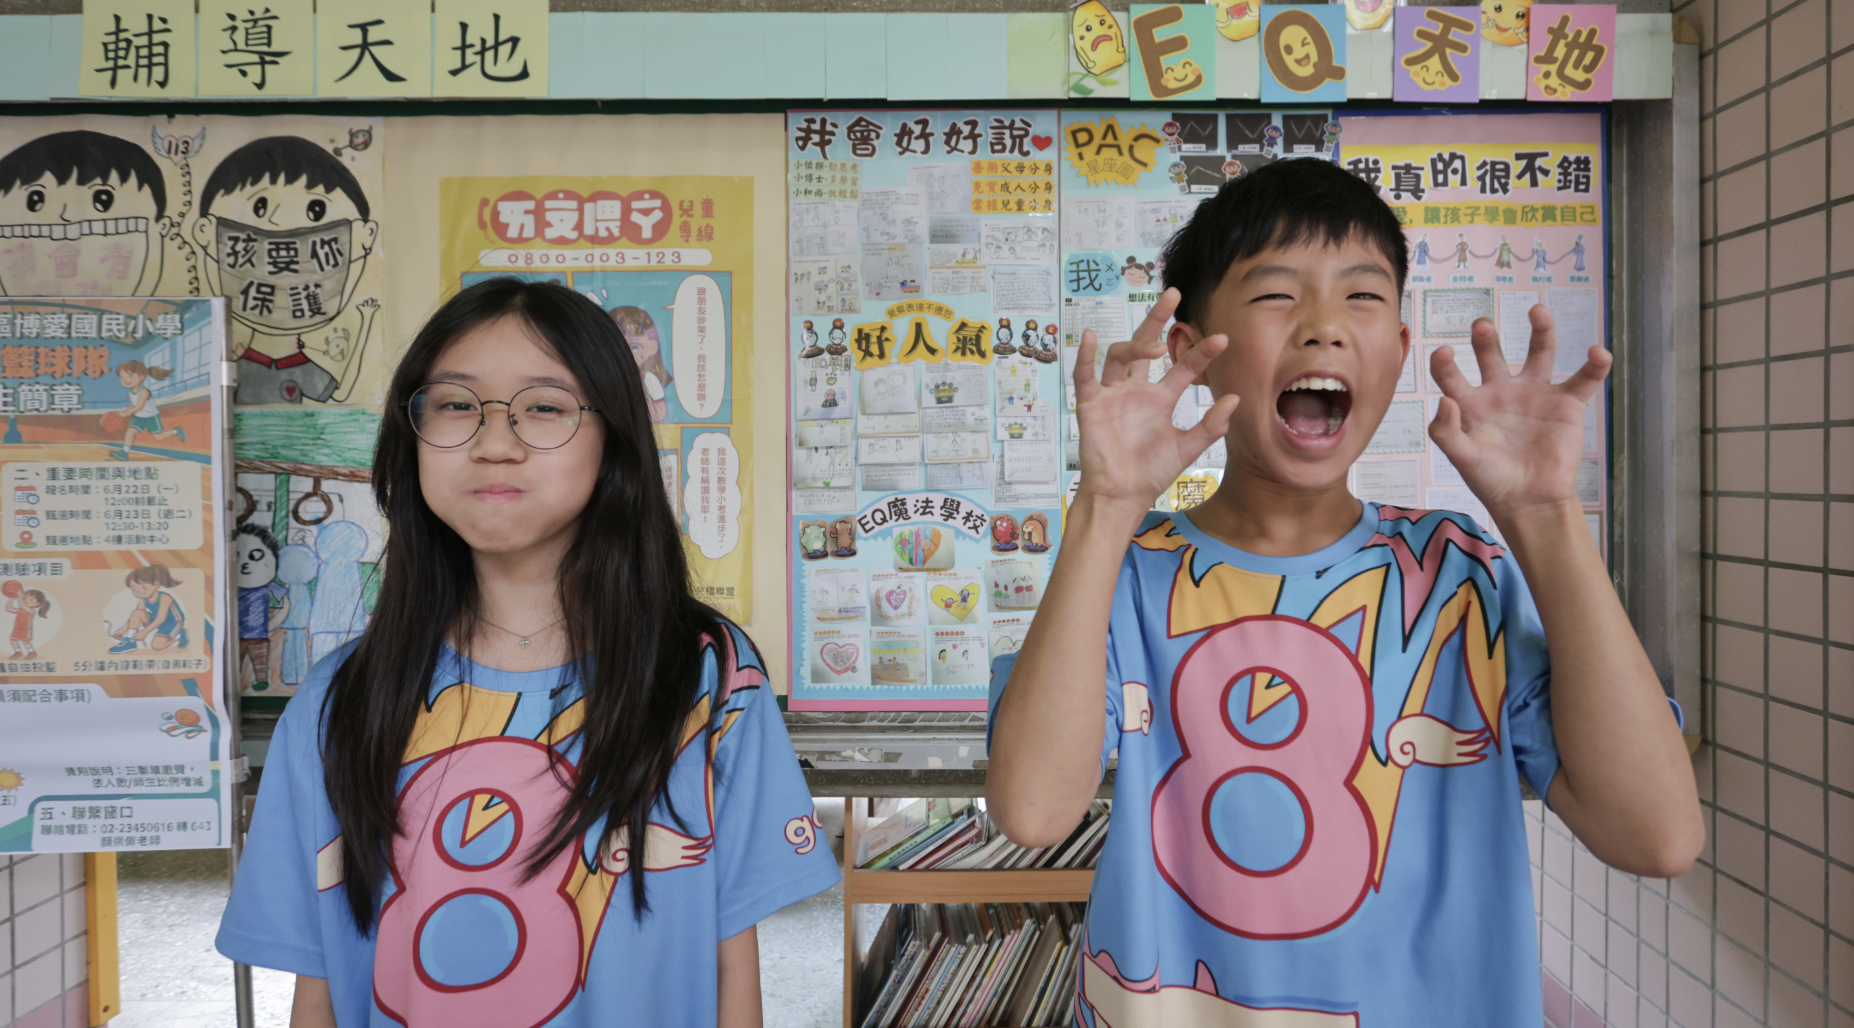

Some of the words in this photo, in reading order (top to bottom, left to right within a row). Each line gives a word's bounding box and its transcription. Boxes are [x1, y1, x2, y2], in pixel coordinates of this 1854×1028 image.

[94, 9, 530, 90] 輔導天地
[166, 139, 191, 157] 113
[795, 116, 1032, 159] 我會好好說
[1071, 124, 1161, 168] PAC
[1086, 157, 1135, 180] 星座圖
[1347, 151, 1592, 201] 我真的很不錯
[226, 234, 346, 275] 孩要你
[508, 251, 682, 266] 0800-003-123
[1069, 259, 1102, 293] 我
[240, 280, 328, 320] 保護
[1, 344, 110, 379] 籃球隊
[854, 321, 990, 363] 好人氣
[857, 497, 987, 534] EQ魔法學校
